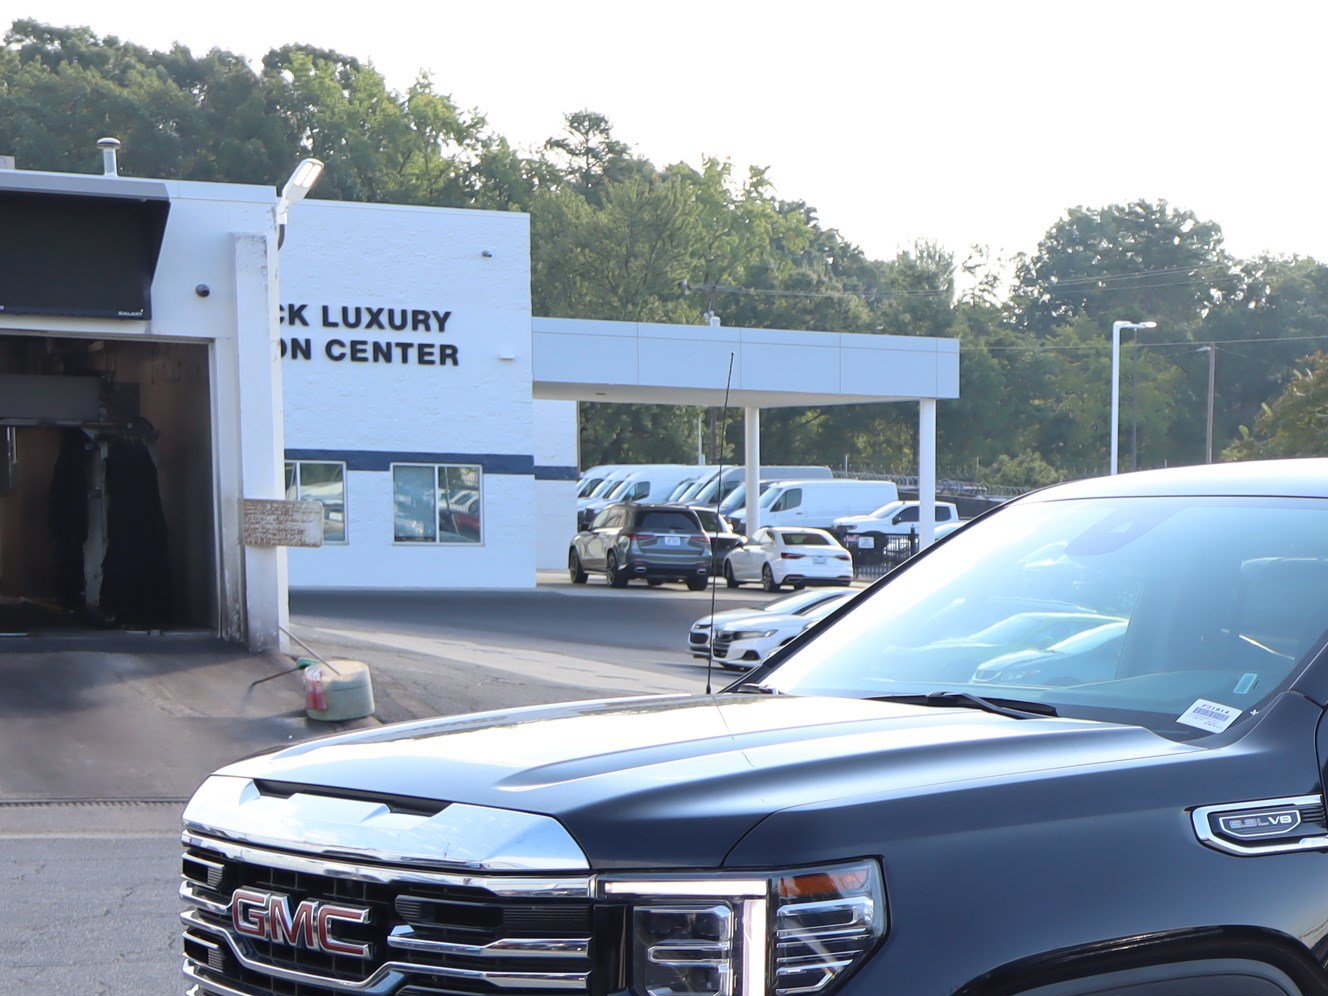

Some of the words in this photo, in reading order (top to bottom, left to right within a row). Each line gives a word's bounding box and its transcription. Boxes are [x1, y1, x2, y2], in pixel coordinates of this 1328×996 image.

[280, 303, 310, 327] K
[322, 304, 452, 333] LUXURY
[325, 338, 459, 367] CENTER
[231, 887, 373, 961] GMC
